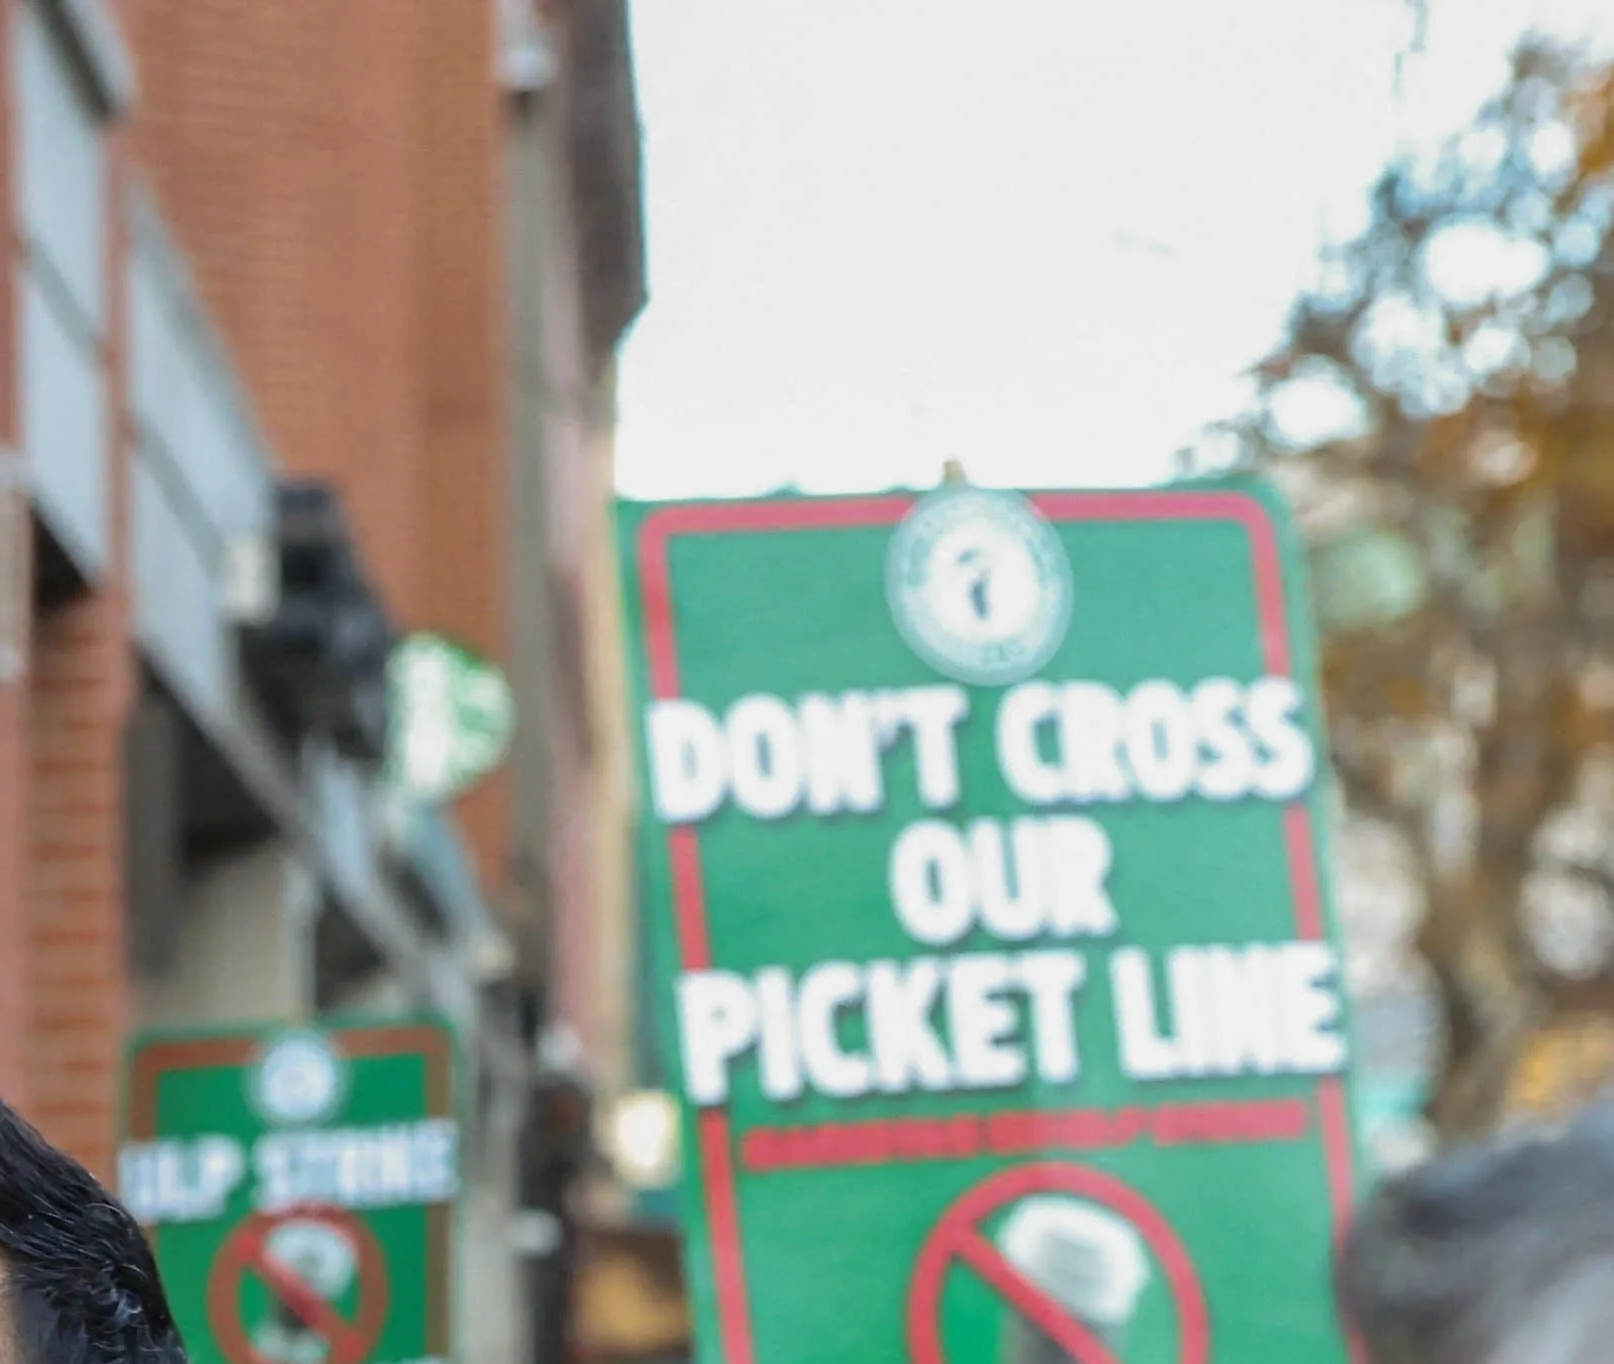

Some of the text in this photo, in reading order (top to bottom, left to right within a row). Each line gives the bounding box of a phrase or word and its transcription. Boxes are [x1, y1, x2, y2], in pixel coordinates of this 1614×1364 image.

[645, 677, 1314, 823] DON'T CROSS
[888, 816, 1119, 945] OUR
[676, 944, 1347, 1104] PICKET LINE
